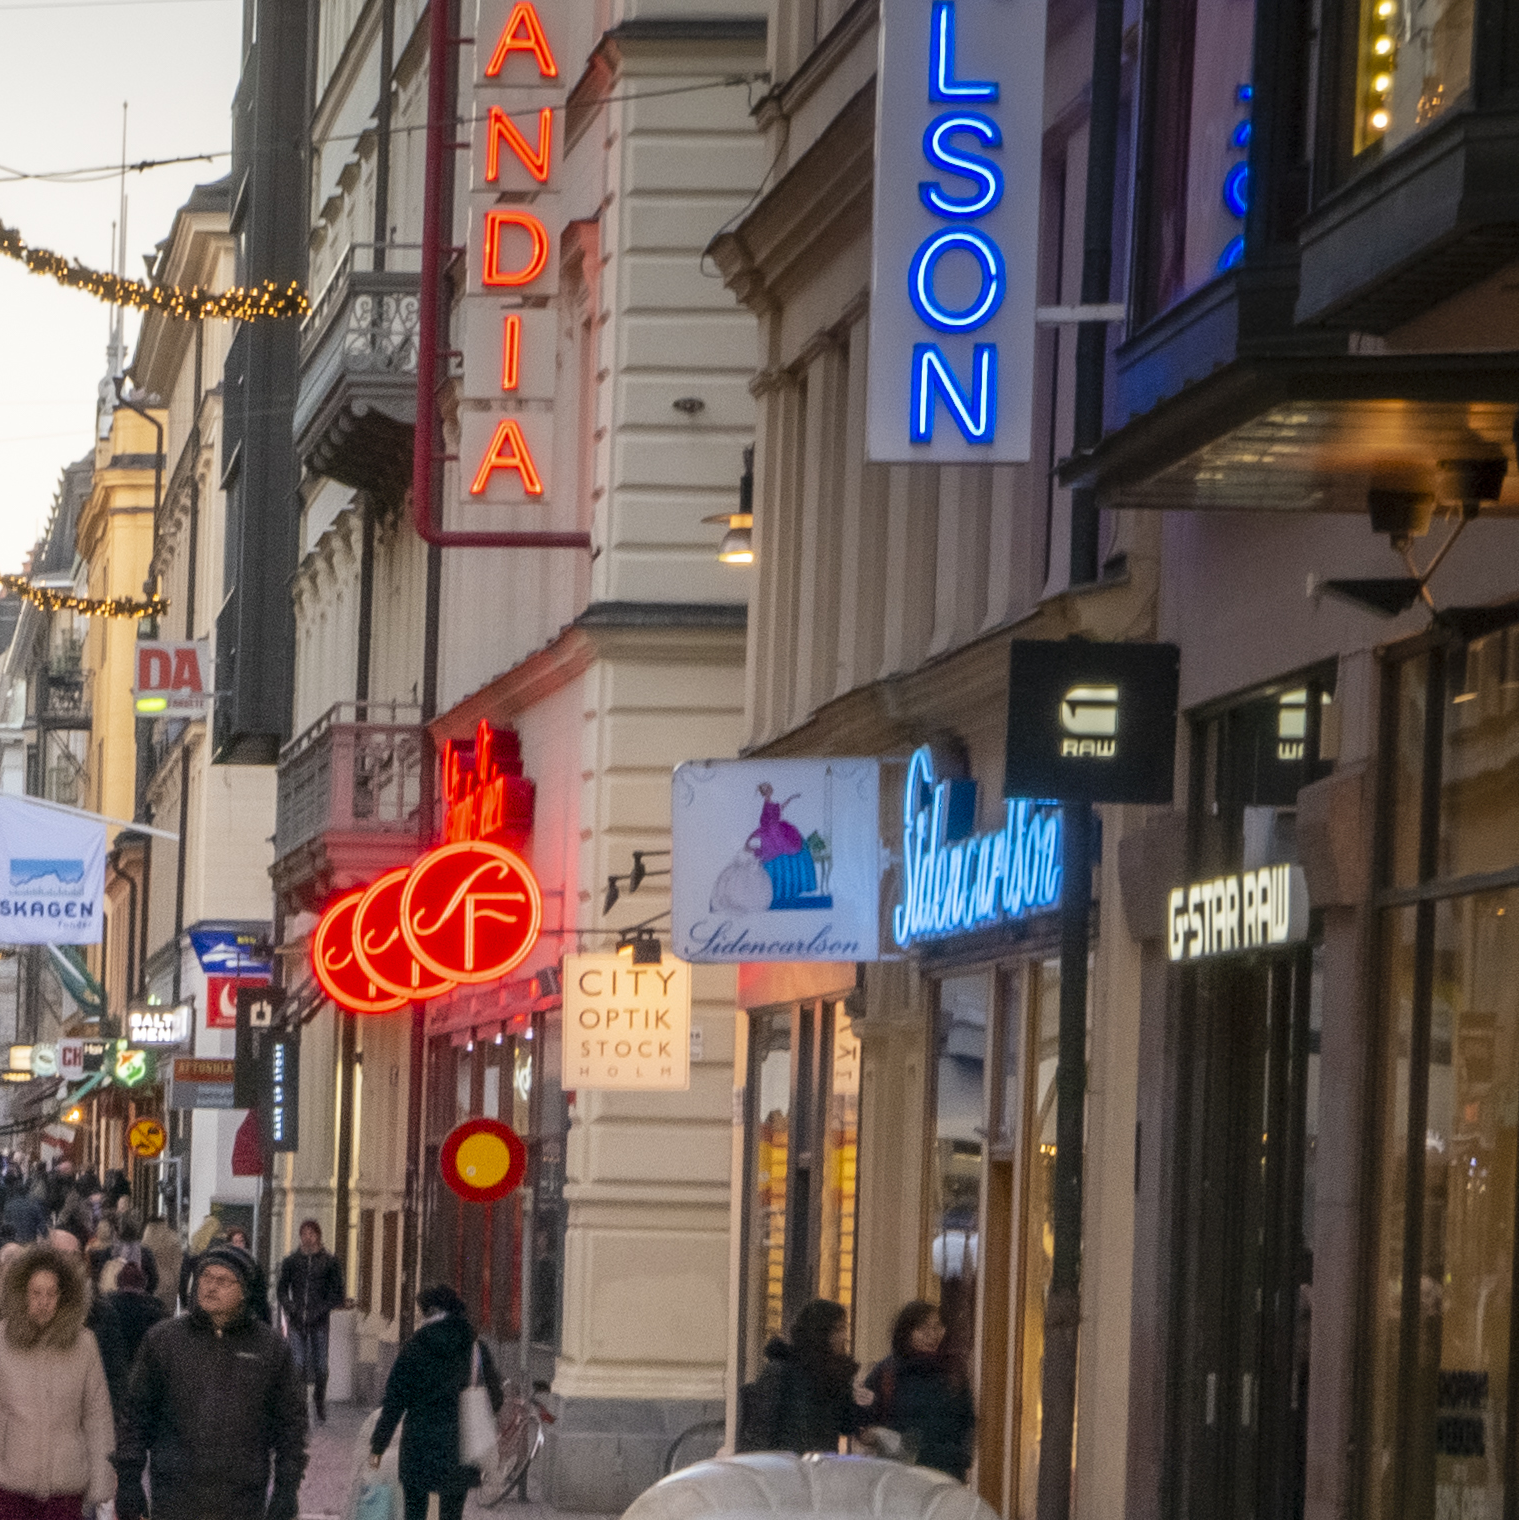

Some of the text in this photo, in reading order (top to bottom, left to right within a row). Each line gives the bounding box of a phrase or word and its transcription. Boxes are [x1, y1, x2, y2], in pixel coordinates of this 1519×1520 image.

[138, 648, 203, 692] DA
[1061, 738, 1118, 758] RAW
[894, 743, 1064, 948] Sidencarlson
[0, 900, 94, 918] SKAGEN
[1243, 862, 1292, 945] RAW
[683, 920, 861, 958] Sidencarlson
[578, 969, 677, 997] CITY
[578, 1008, 672, 1031] OPTIK
[580, 1040, 672, 1059] STOCK
[178, 1062, 235, 1074] AFTONBLA
[578, 1066, 672, 1079] HOLM
